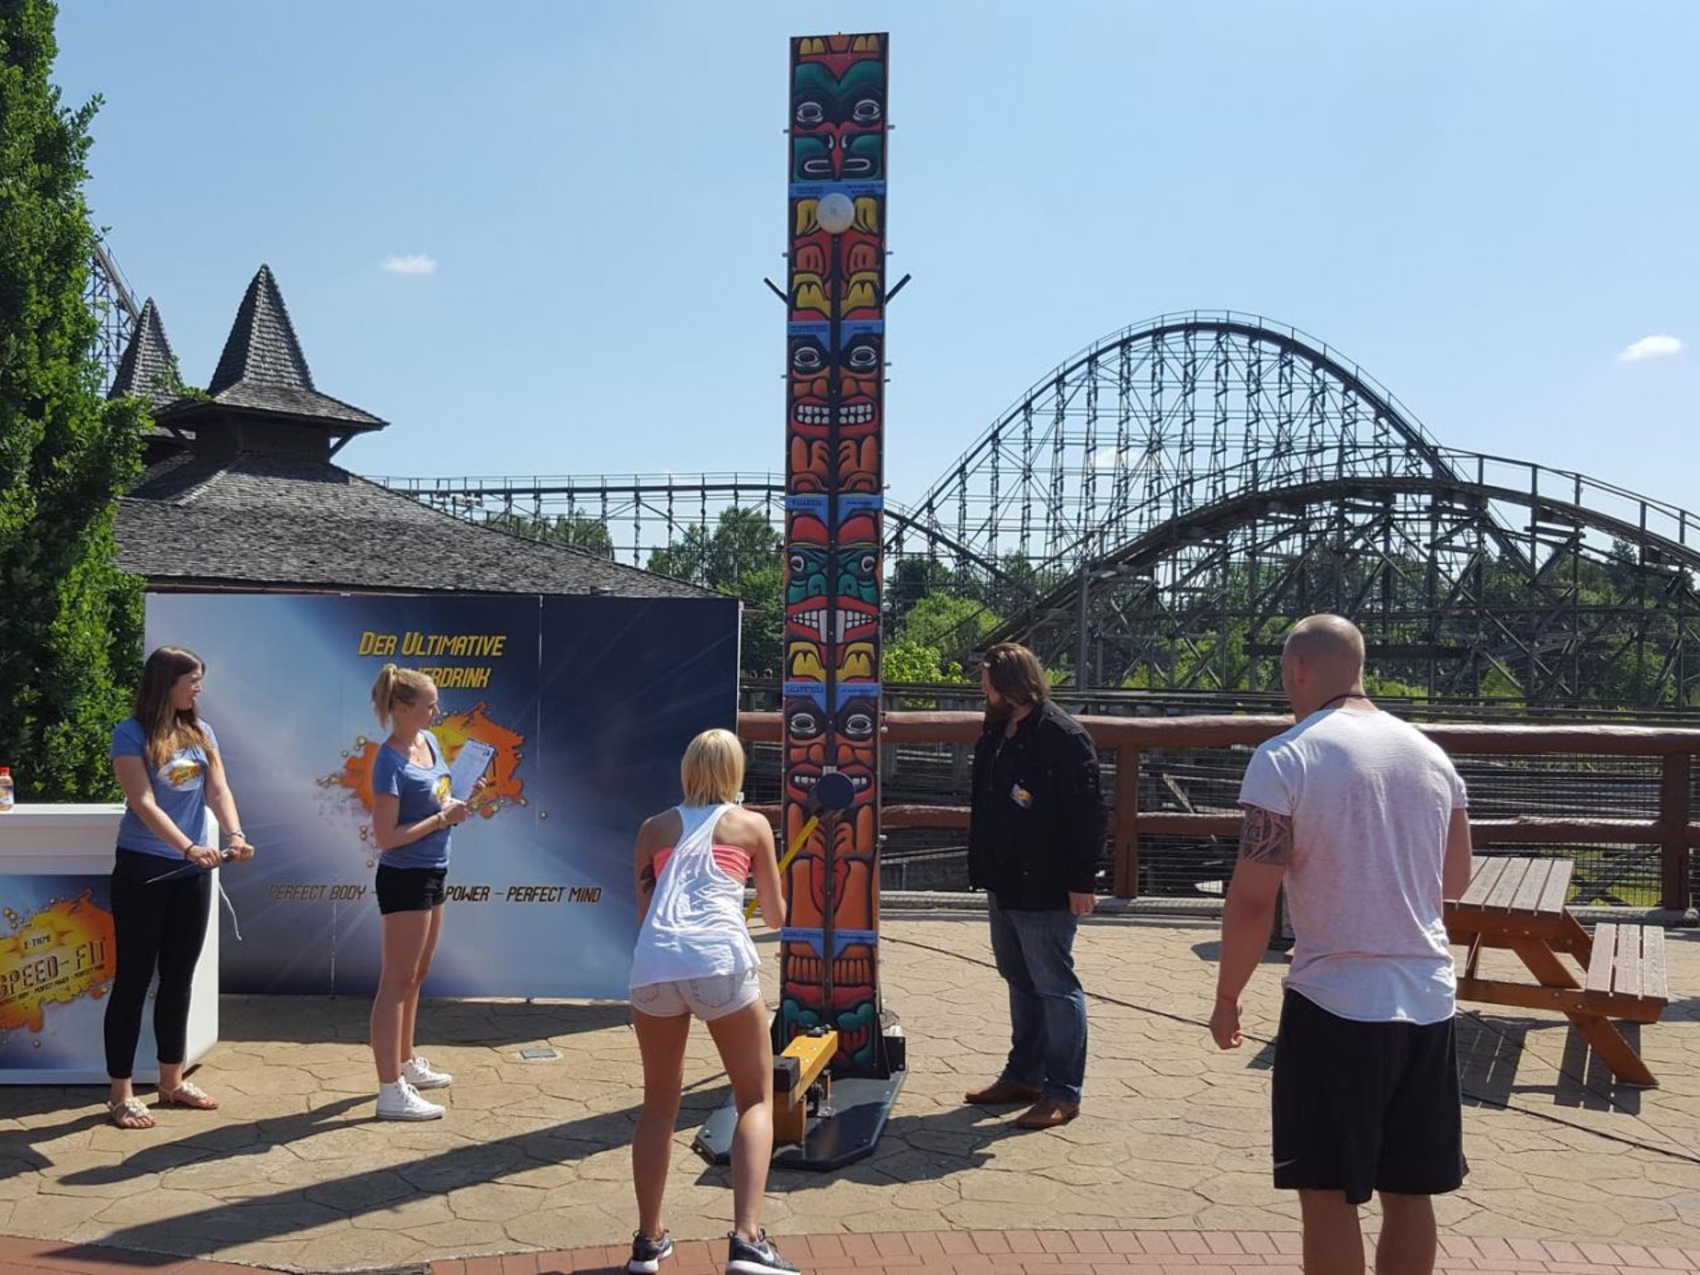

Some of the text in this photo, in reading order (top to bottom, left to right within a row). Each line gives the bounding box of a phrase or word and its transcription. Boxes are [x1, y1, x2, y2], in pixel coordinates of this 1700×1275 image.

[418, 667, 491, 688] RDRINK
[269, 885, 327, 900] PERFECT
[329, 885, 367, 901] BODY
[444, 886, 491, 902] POWER
[506, 886, 567, 902] PERFECT
[568, 886, 602, 903] MIND
